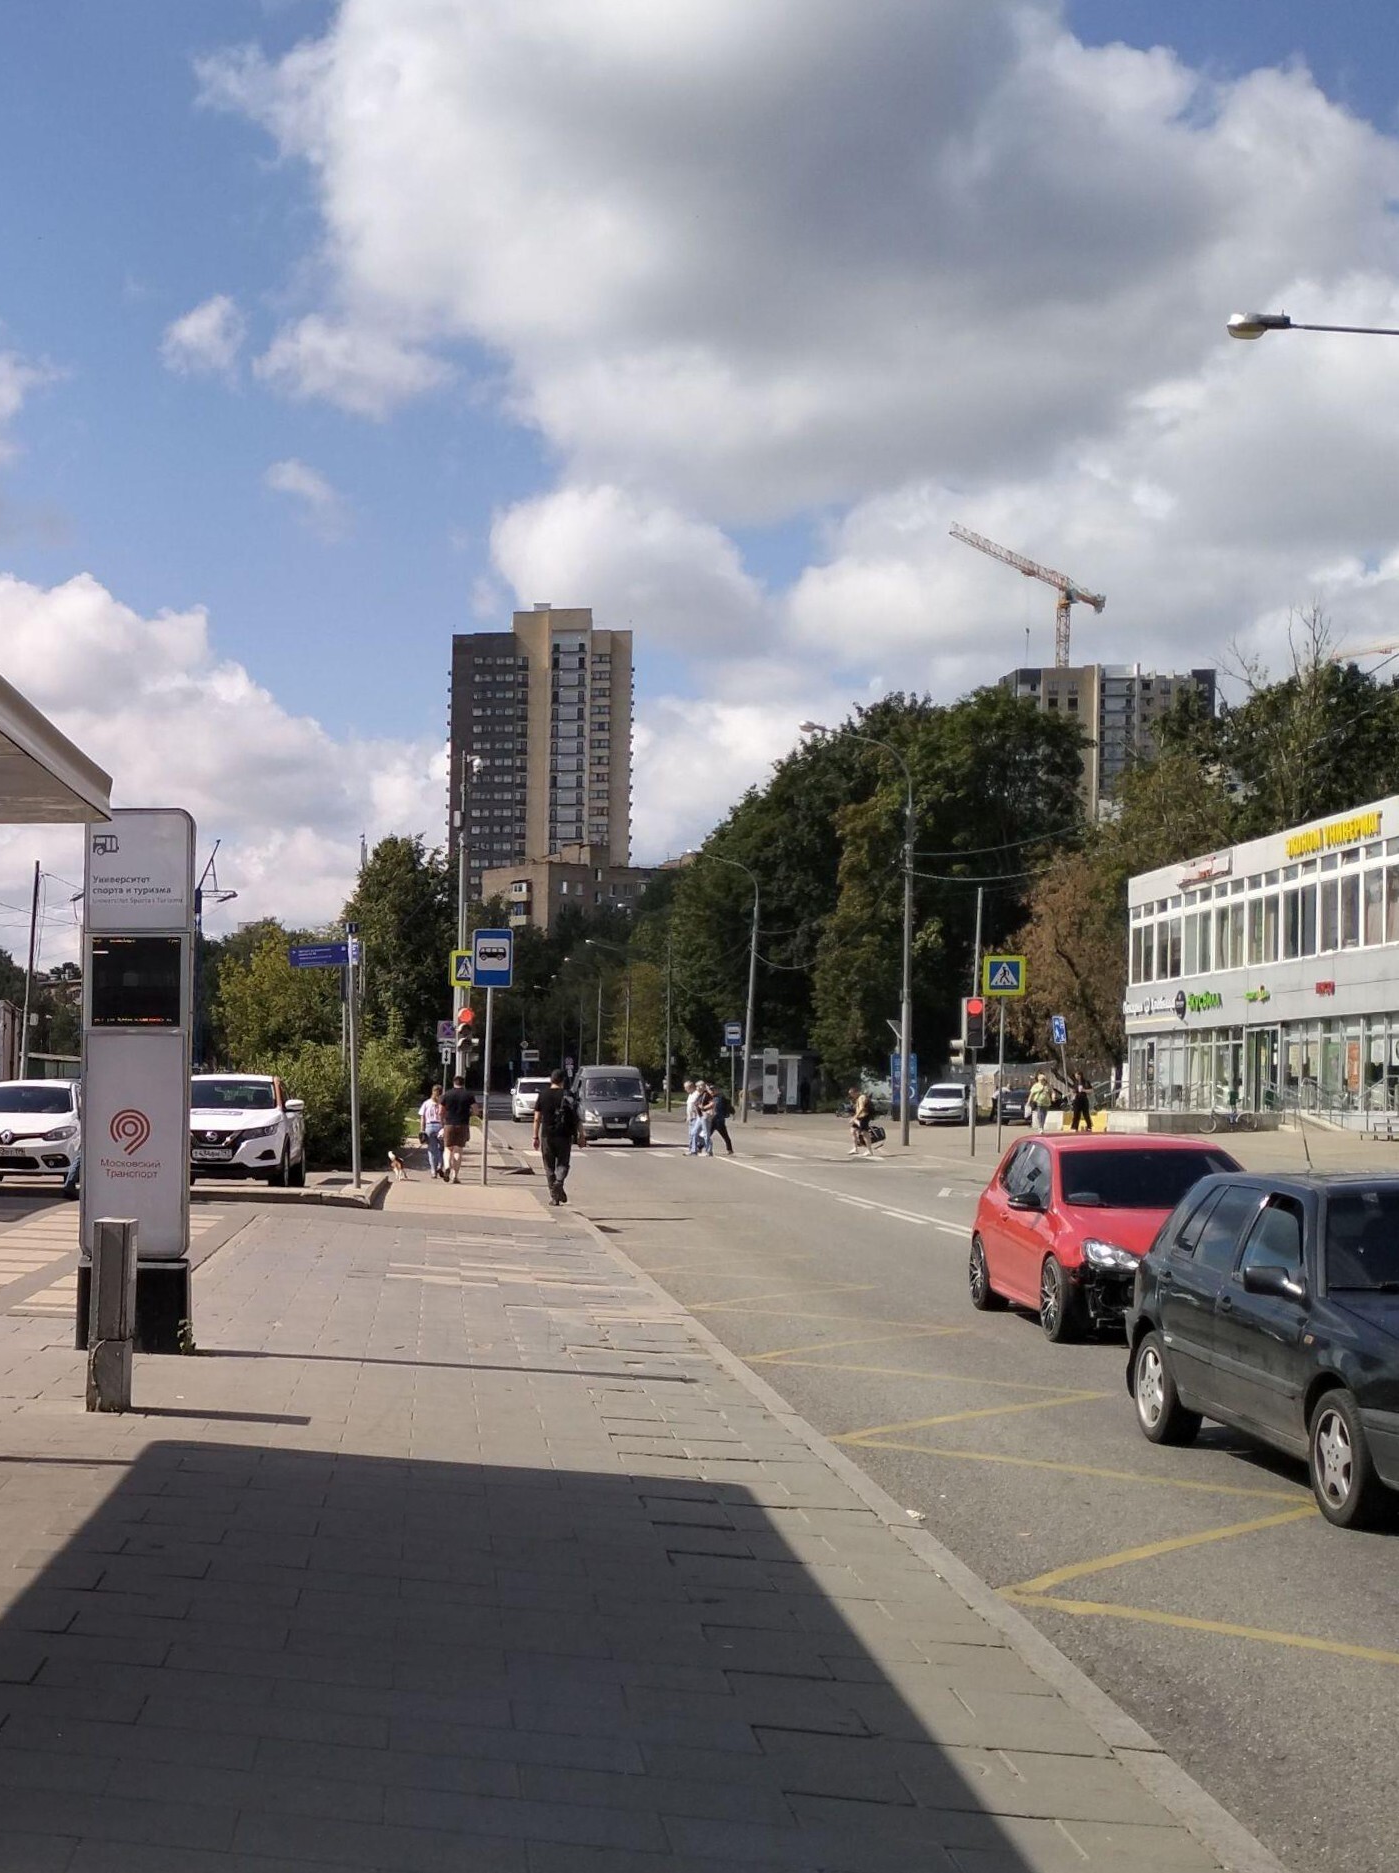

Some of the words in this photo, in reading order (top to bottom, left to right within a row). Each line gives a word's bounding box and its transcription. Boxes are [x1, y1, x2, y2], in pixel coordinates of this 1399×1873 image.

[92, 875, 150, 884] Университет
[92, 887, 124, 896] спорта
[134, 887, 171, 896] туризма
[100, 1158, 161, 1168] Московский
[106, 1169, 158, 1178] Транспорт
